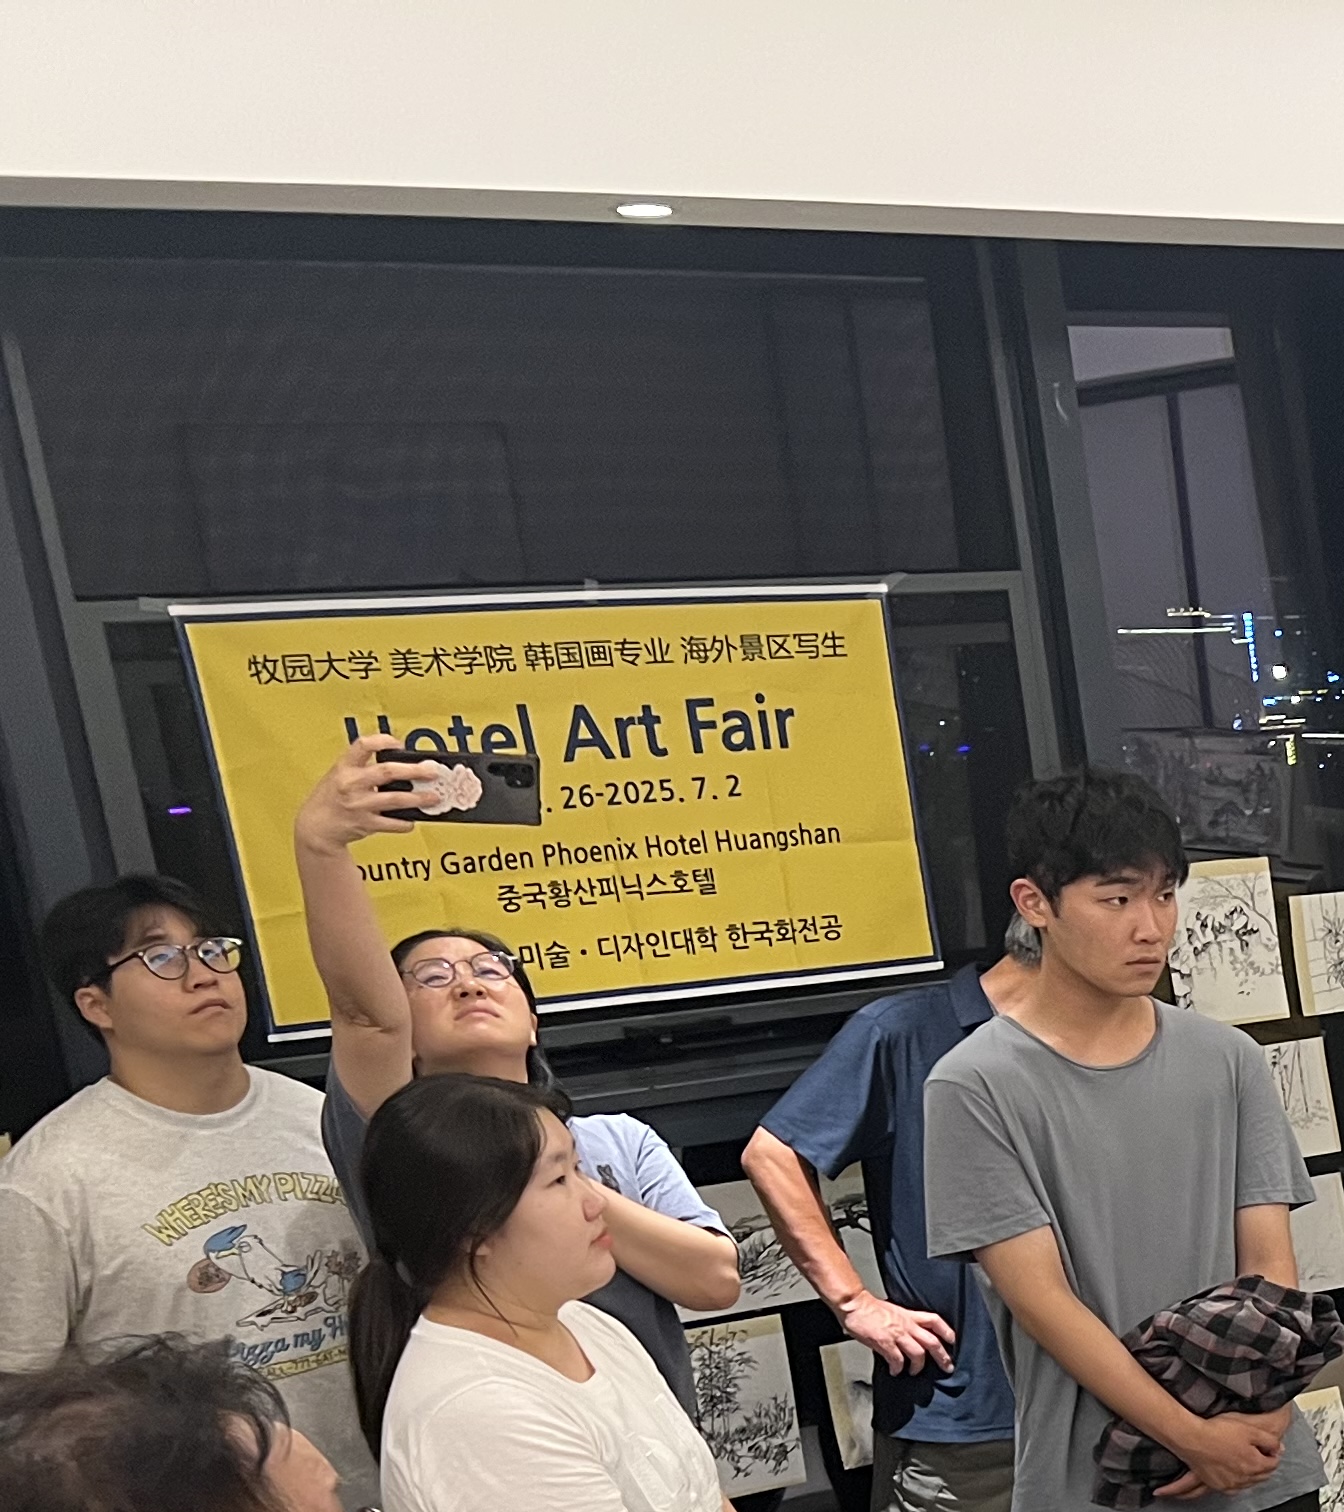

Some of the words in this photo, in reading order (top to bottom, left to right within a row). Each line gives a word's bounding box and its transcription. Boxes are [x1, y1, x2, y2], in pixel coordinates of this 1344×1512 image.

[248, 649, 382, 685] 牧园大学
[388, 643, 518, 679] 美术学院
[522, 636, 675, 672] 韩国画专业
[679, 630, 849, 666] 海外景区写生
[563, 704, 669, 763] Art
[685, 692, 796, 755] Fair
[725, 774, 742, 798] 2
[440, 846, 534, 876] Garden
[542, 837, 639, 867] Phoenix
[645, 829, 708, 859] Hotel
[714, 822, 841, 852] Huangshan
[496, 867, 719, 914] 중국황산피닉스호텔
[519, 939, 571, 971] 미술
[596, 925, 719, 963] 디자인대학
[725, 913, 844, 952] 한국화전공
[230, 1173, 274, 1208] MY
